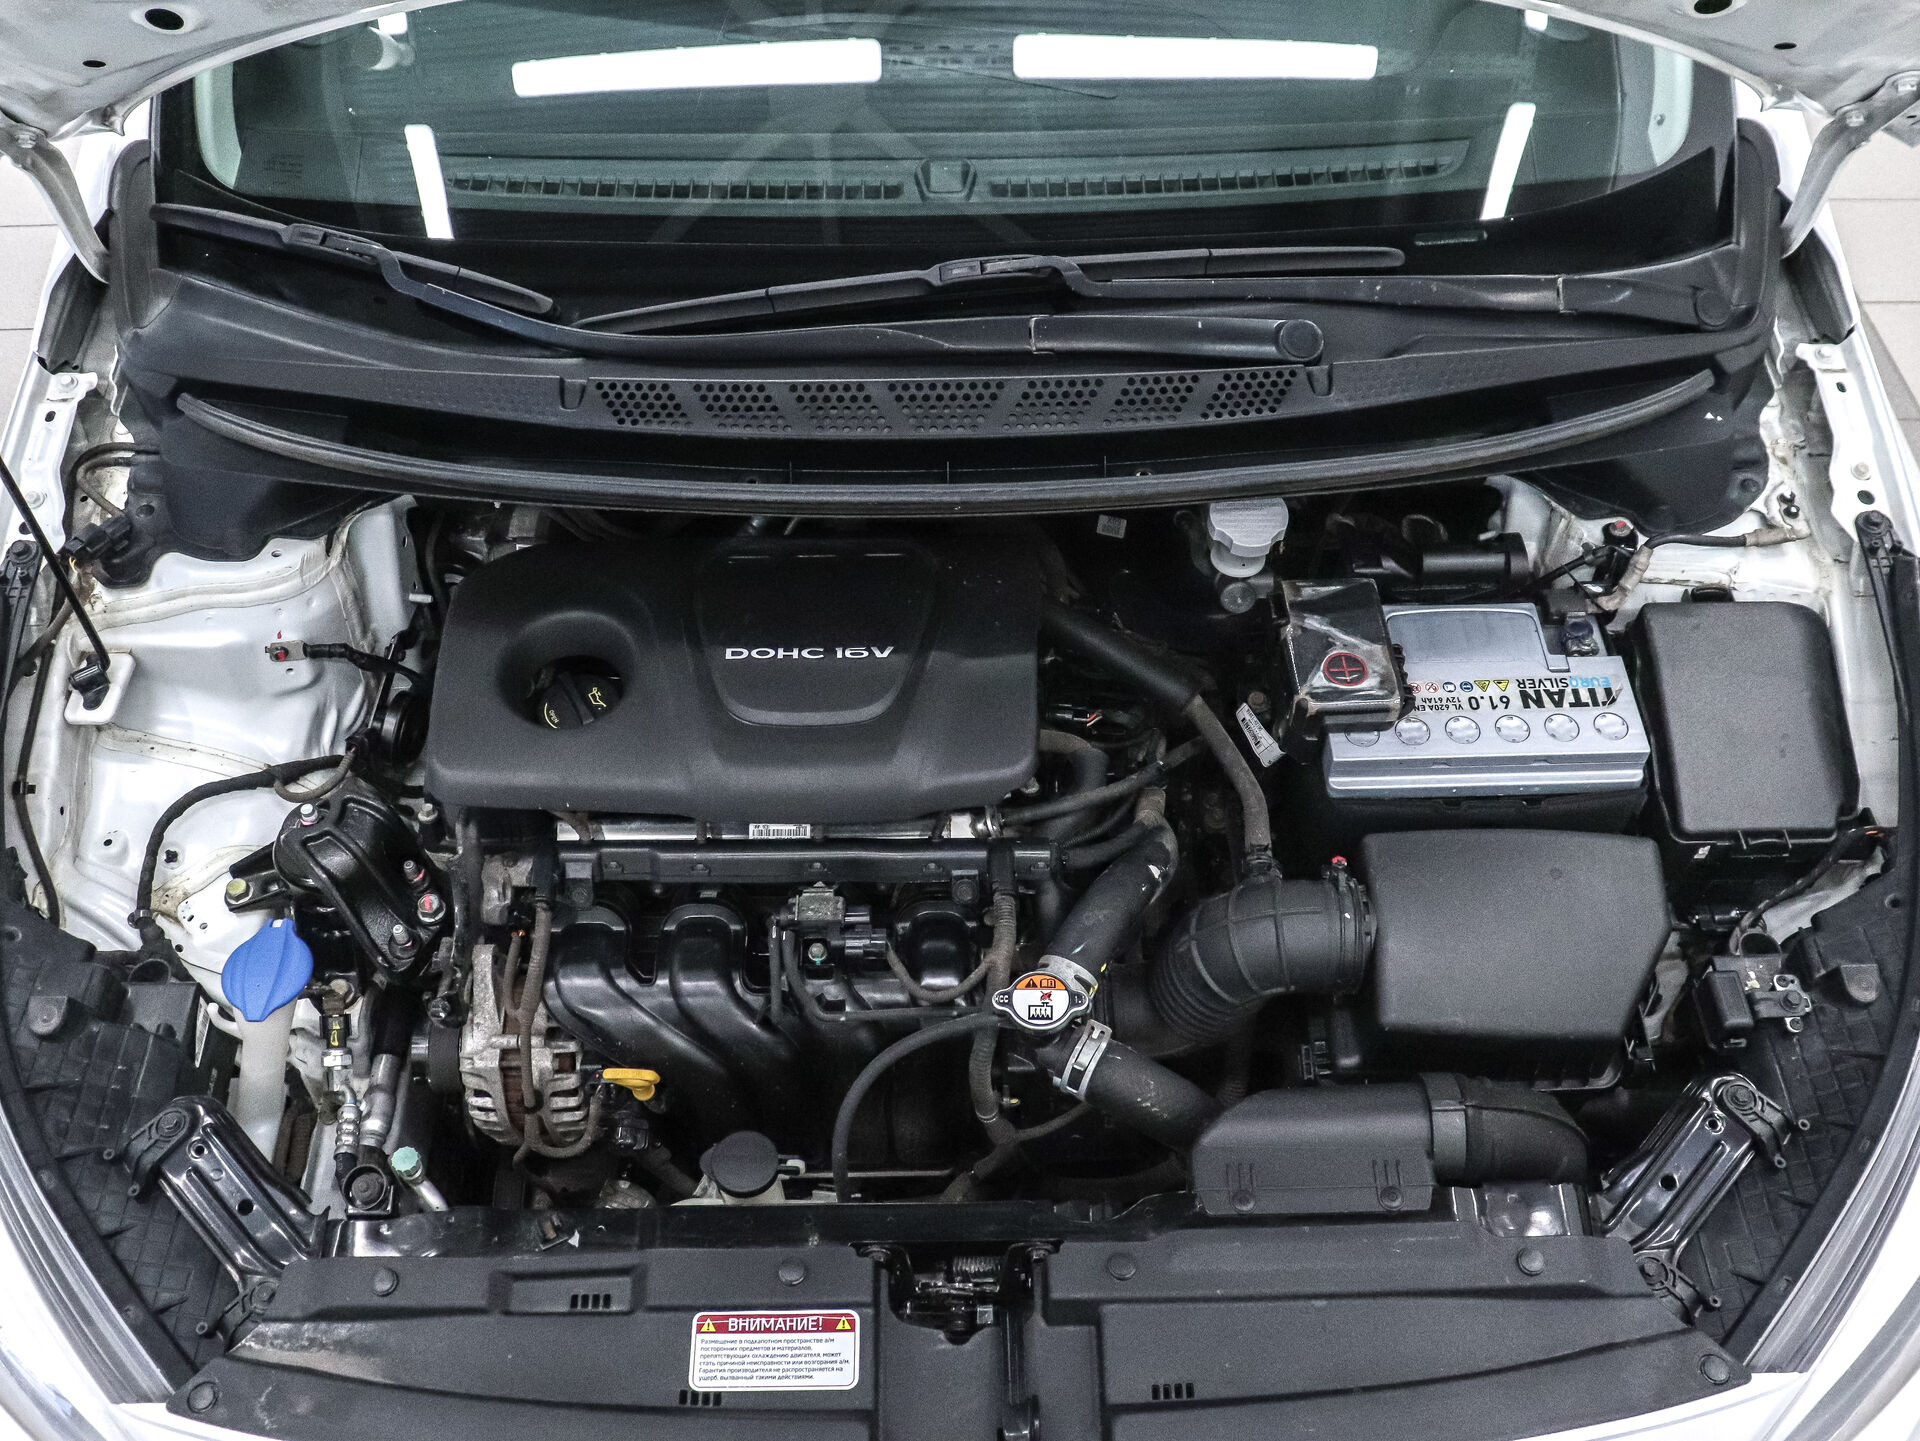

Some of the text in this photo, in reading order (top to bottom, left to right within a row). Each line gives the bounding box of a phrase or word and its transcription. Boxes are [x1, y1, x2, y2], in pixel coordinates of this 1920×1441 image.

[725, 646, 894, 660] DOHC 16V
[1468, 695, 1511, 711] 61.0
[1519, 687, 1619, 710] TITAN
[548, 709, 560, 724] OPEN
[728, 1316, 824, 1332] ВНИМАНИЕ!
